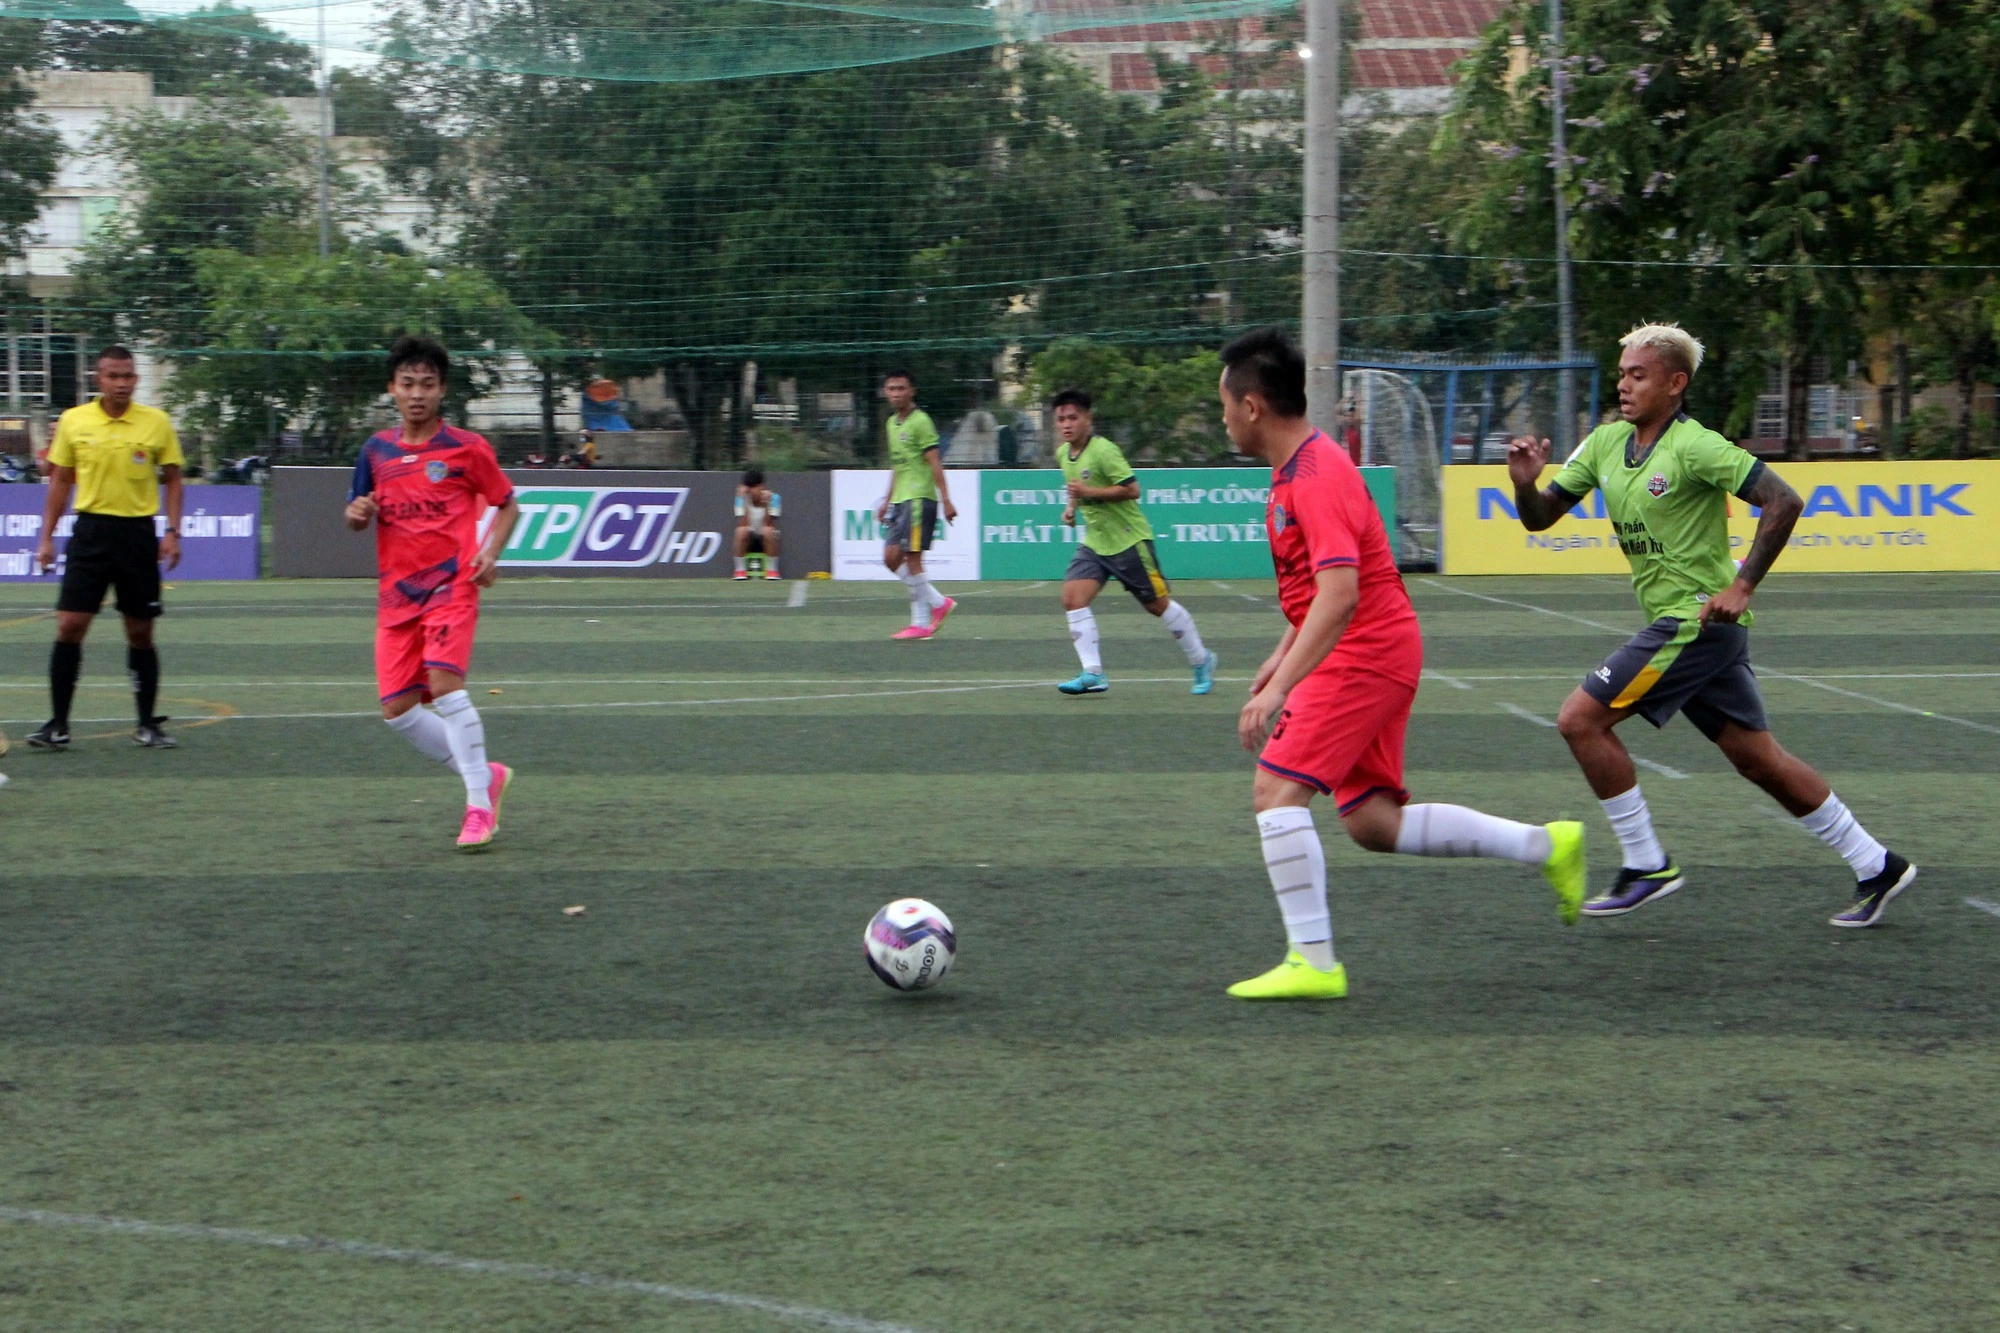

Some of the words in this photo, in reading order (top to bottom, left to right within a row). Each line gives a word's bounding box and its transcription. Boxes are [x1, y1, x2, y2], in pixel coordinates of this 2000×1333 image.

[1147, 484, 1206, 504] PHÁP
[1749, 483, 1974, 517] ANK
[983, 519, 1056, 543] PHÁT
[1876, 528, 1927, 546] Tốt
[658, 531, 722, 564] HD
[1526, 534, 1602, 551] Ngân
